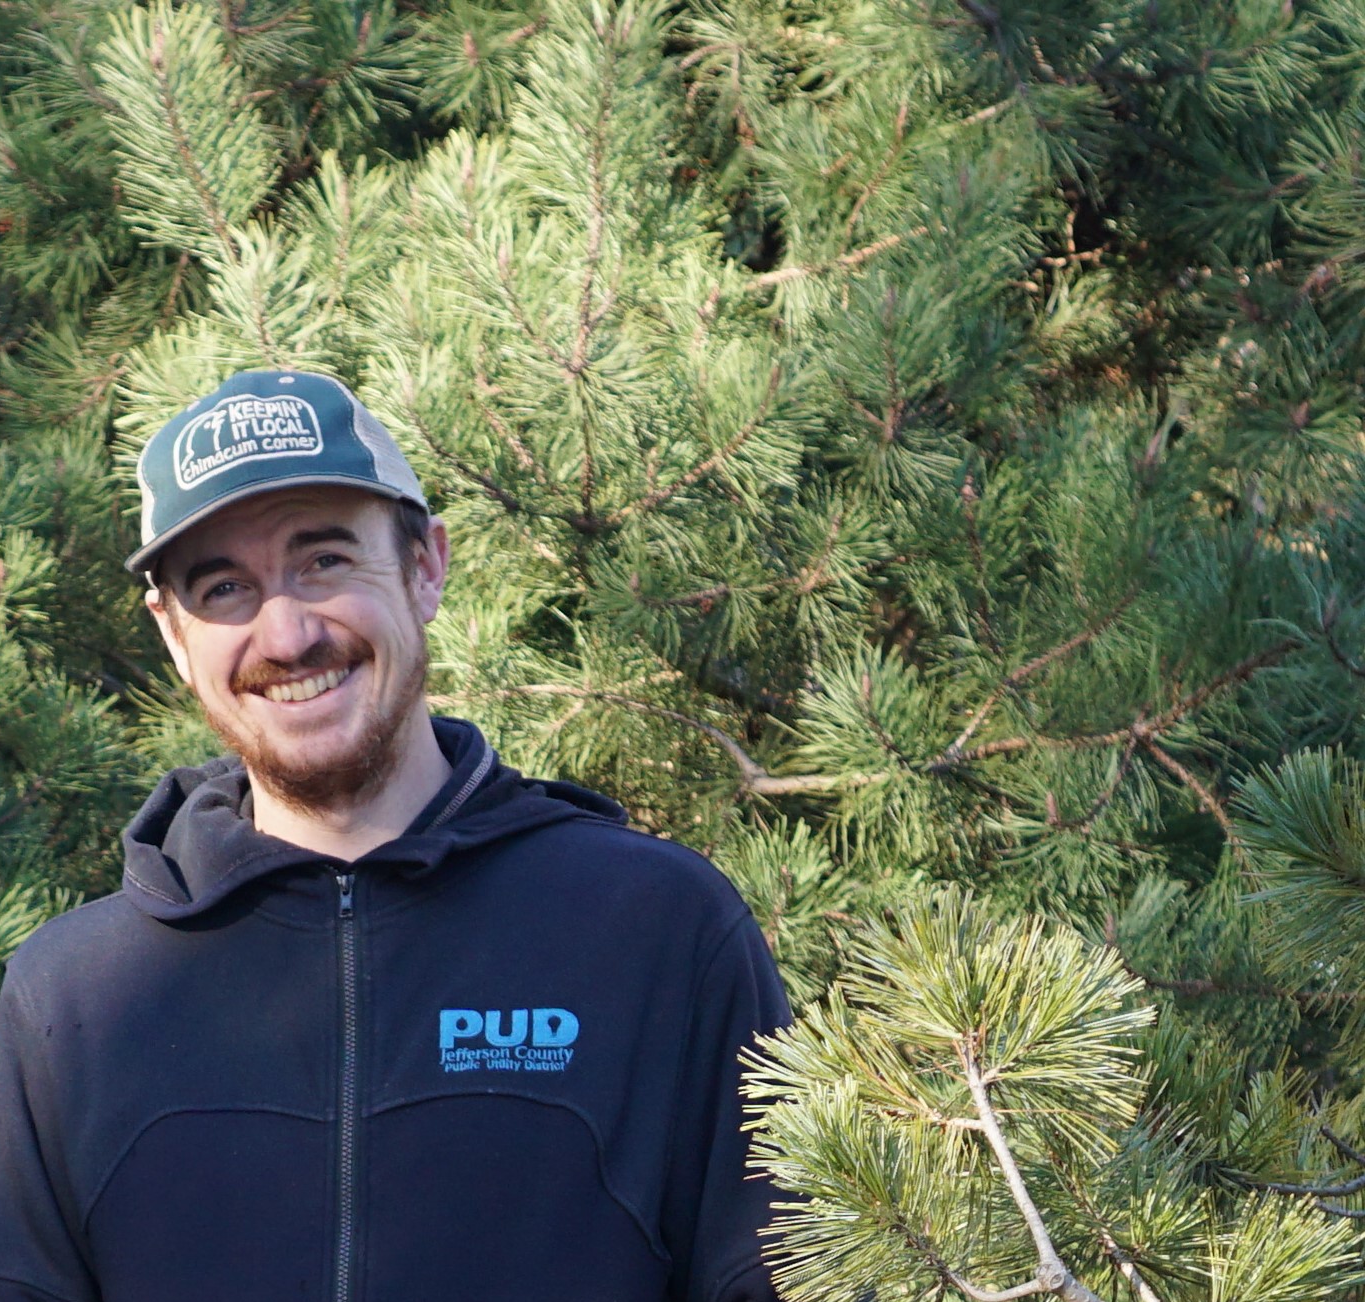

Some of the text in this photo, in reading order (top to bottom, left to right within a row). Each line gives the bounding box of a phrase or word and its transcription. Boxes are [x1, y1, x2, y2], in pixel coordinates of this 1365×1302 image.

[228, 400, 303, 421] KEEPIN'
[231, 418, 311, 441] IT LOCAL
[262, 436, 317, 451] corner
[439, 1008, 580, 1048] PUD
[439, 1045, 574, 1065] Jefferson County
[444, 1059, 566, 1072] Public Utility District
